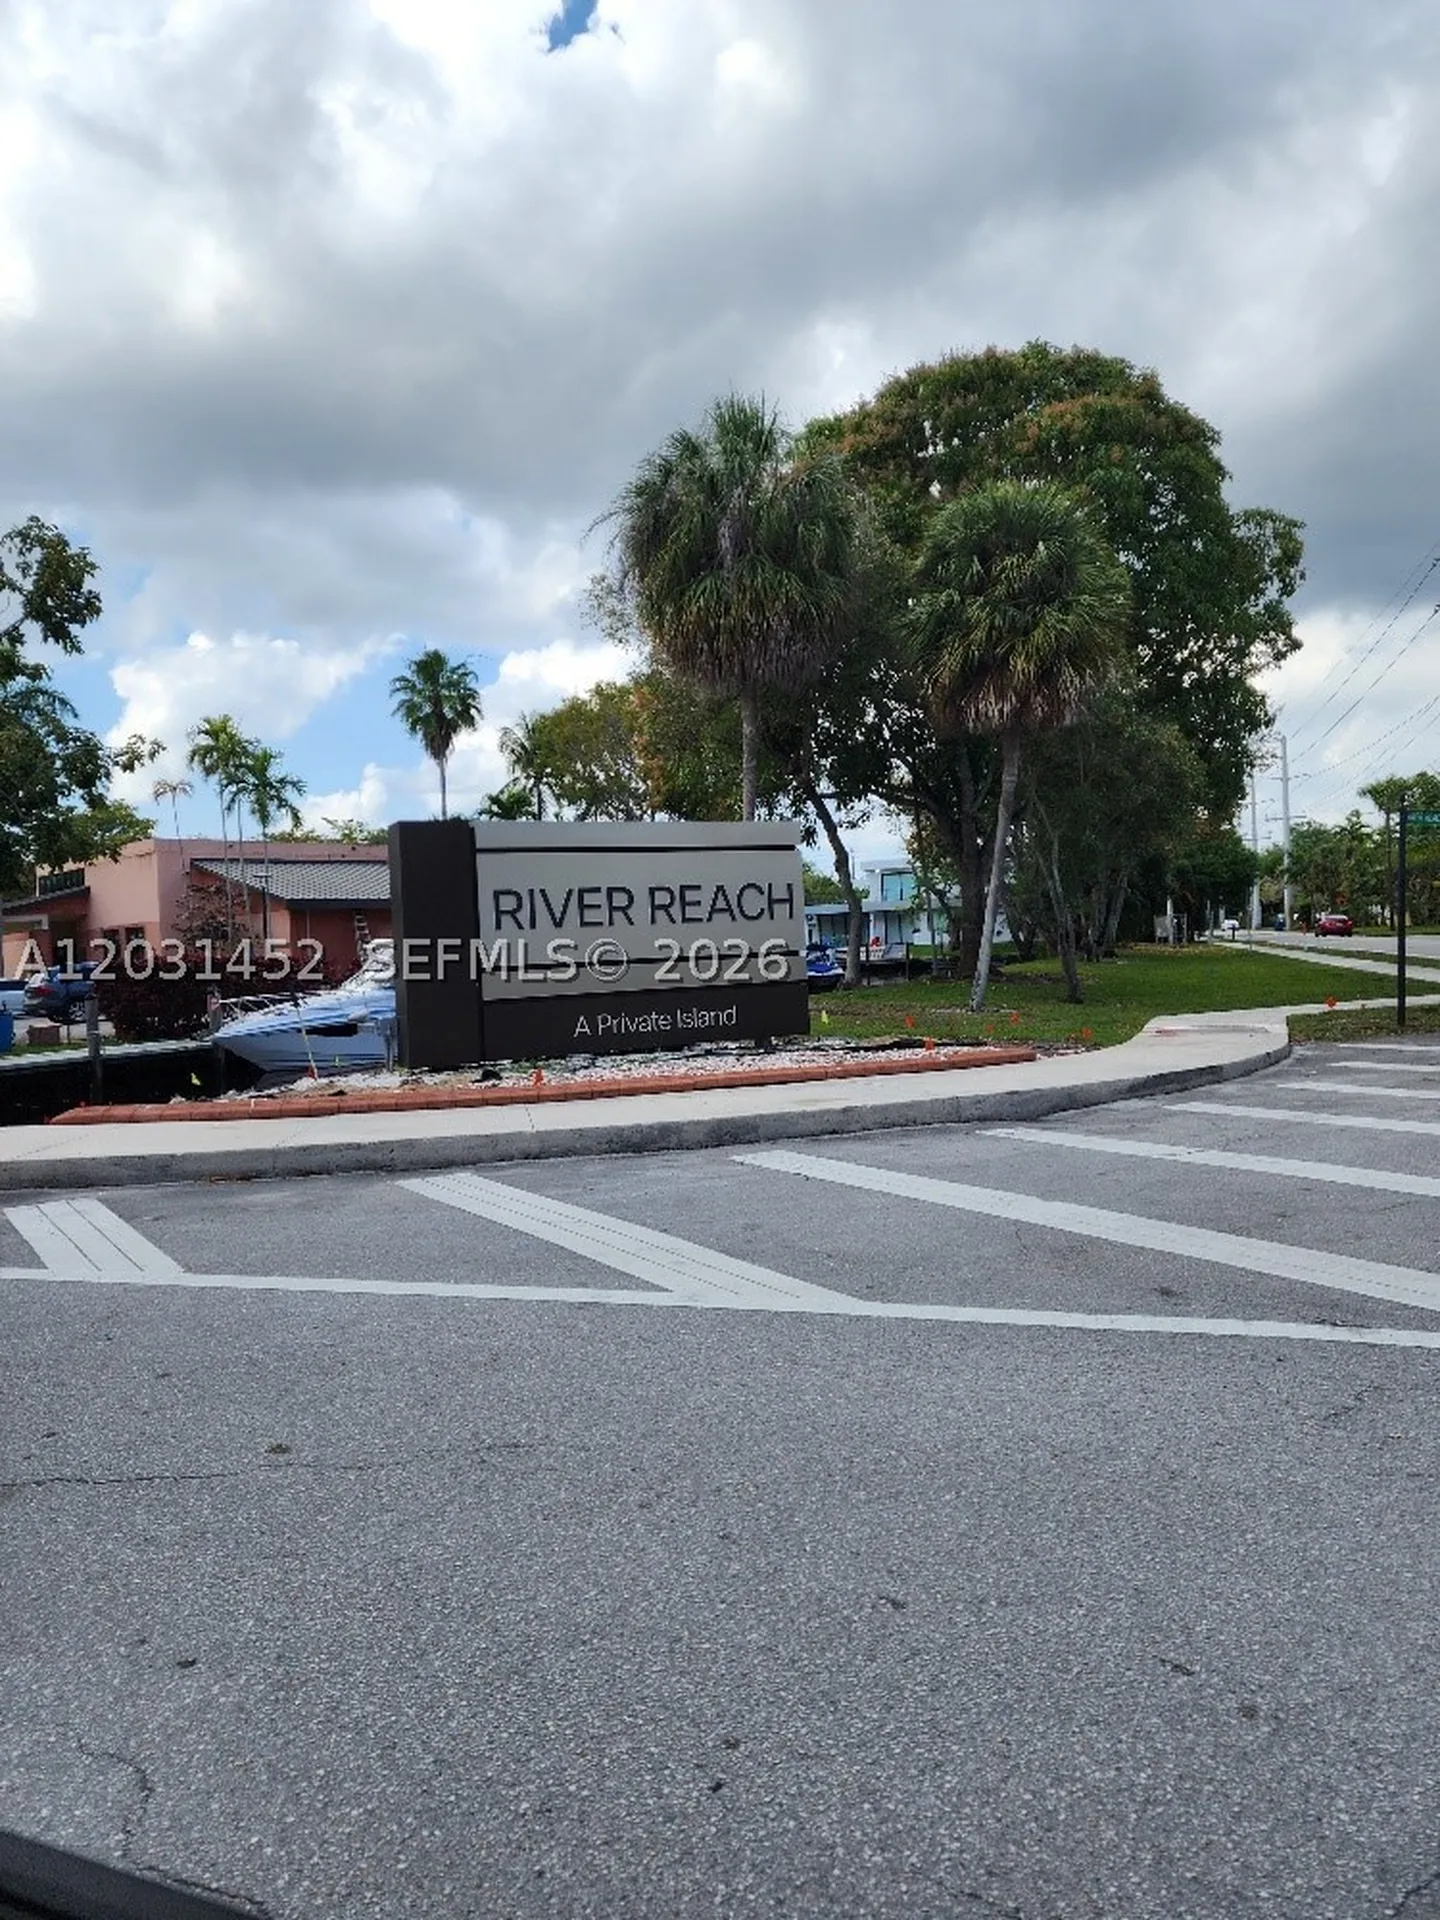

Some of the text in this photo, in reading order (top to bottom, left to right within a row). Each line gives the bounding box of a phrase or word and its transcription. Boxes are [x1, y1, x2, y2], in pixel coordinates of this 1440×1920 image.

[492, 882, 794, 931] RIVER REACH
[573, 1004, 738, 1038] A Private Island
